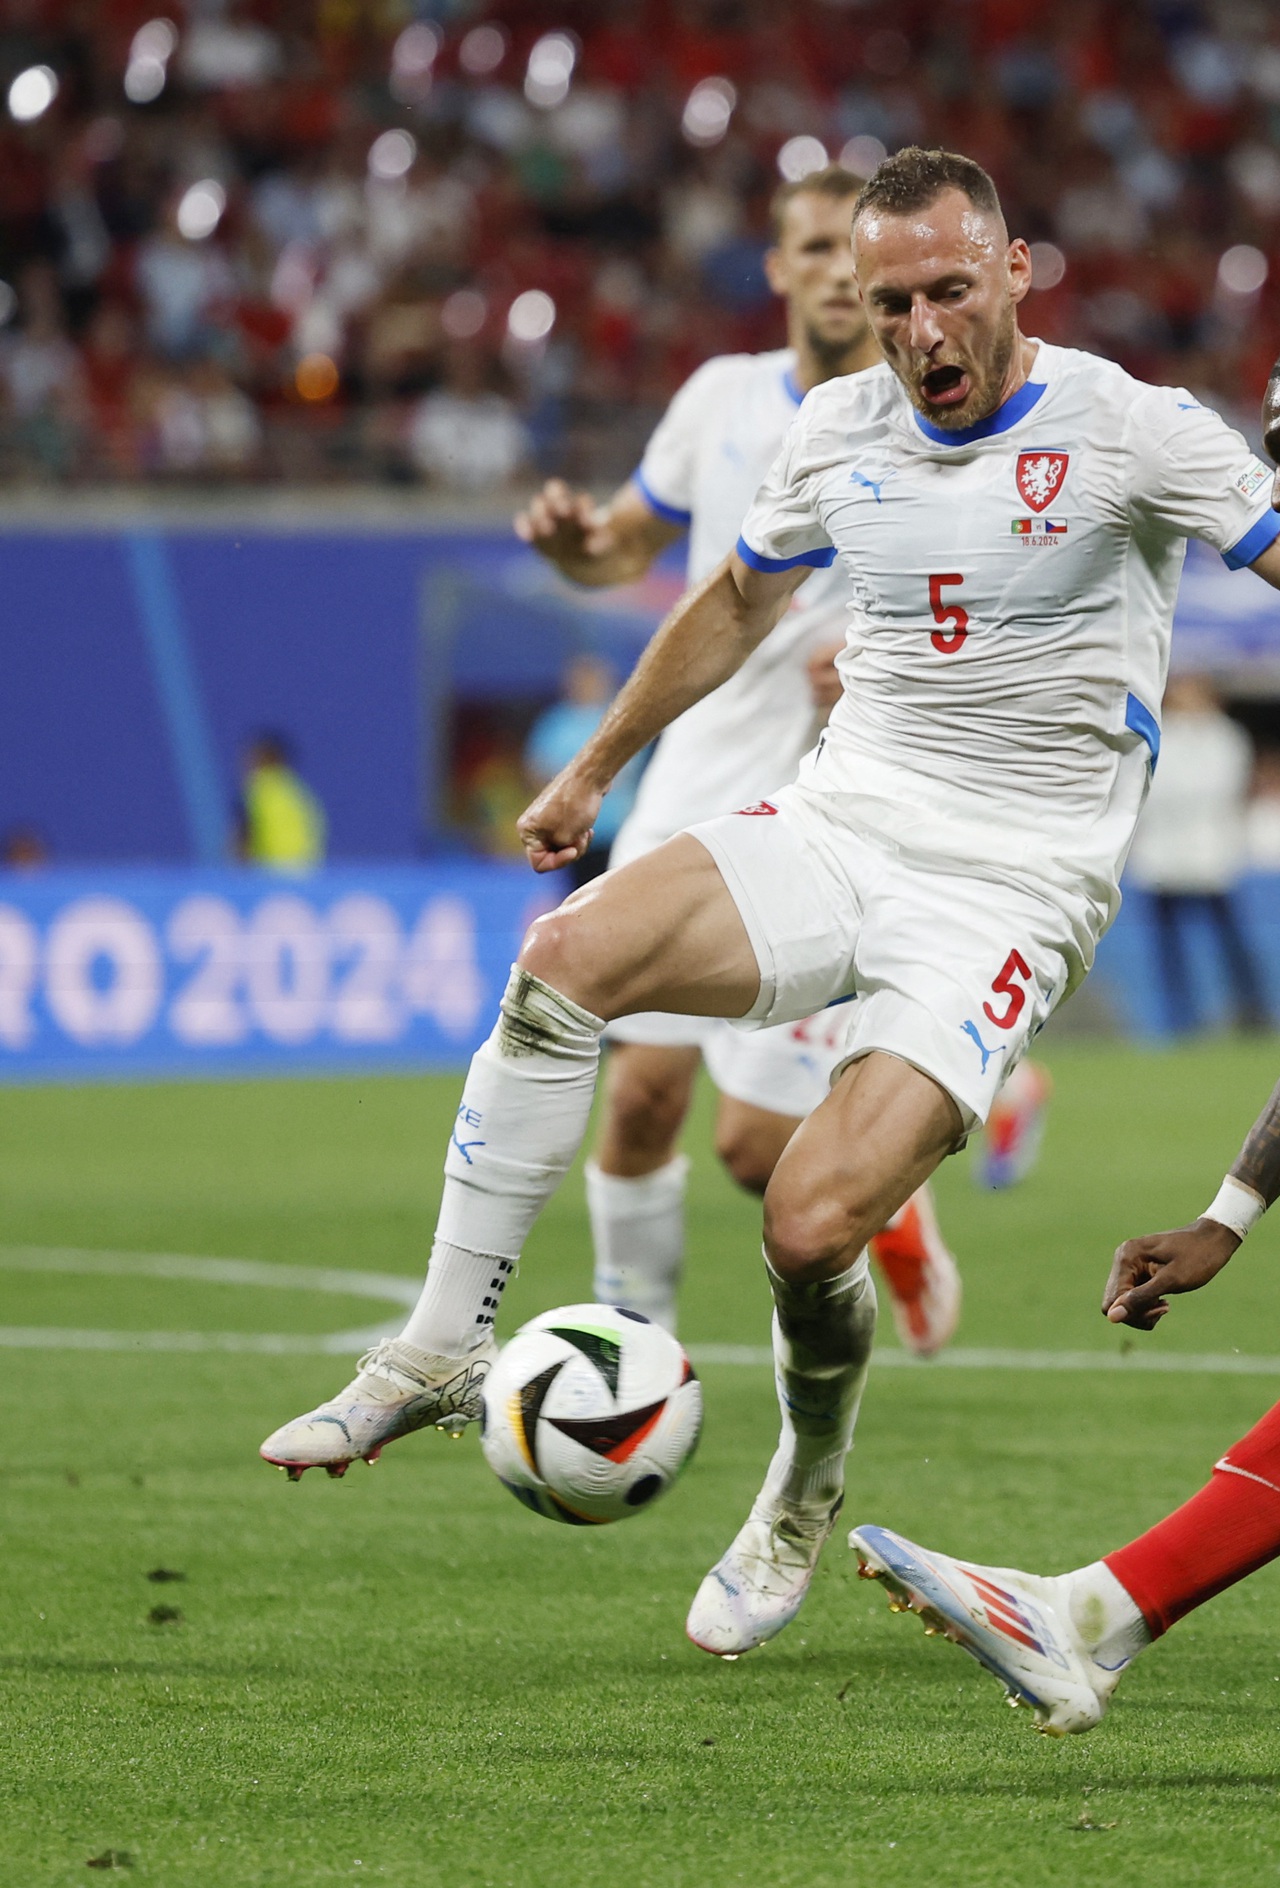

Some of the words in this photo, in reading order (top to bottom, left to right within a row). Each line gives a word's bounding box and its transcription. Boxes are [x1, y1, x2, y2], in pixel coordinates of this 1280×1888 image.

[1021, 536, 1059, 548] 18.6.2024
[928, 572, 969, 655] 5
[165, 890, 485, 1047] 2024
[982, 947, 1033, 1030] 5
